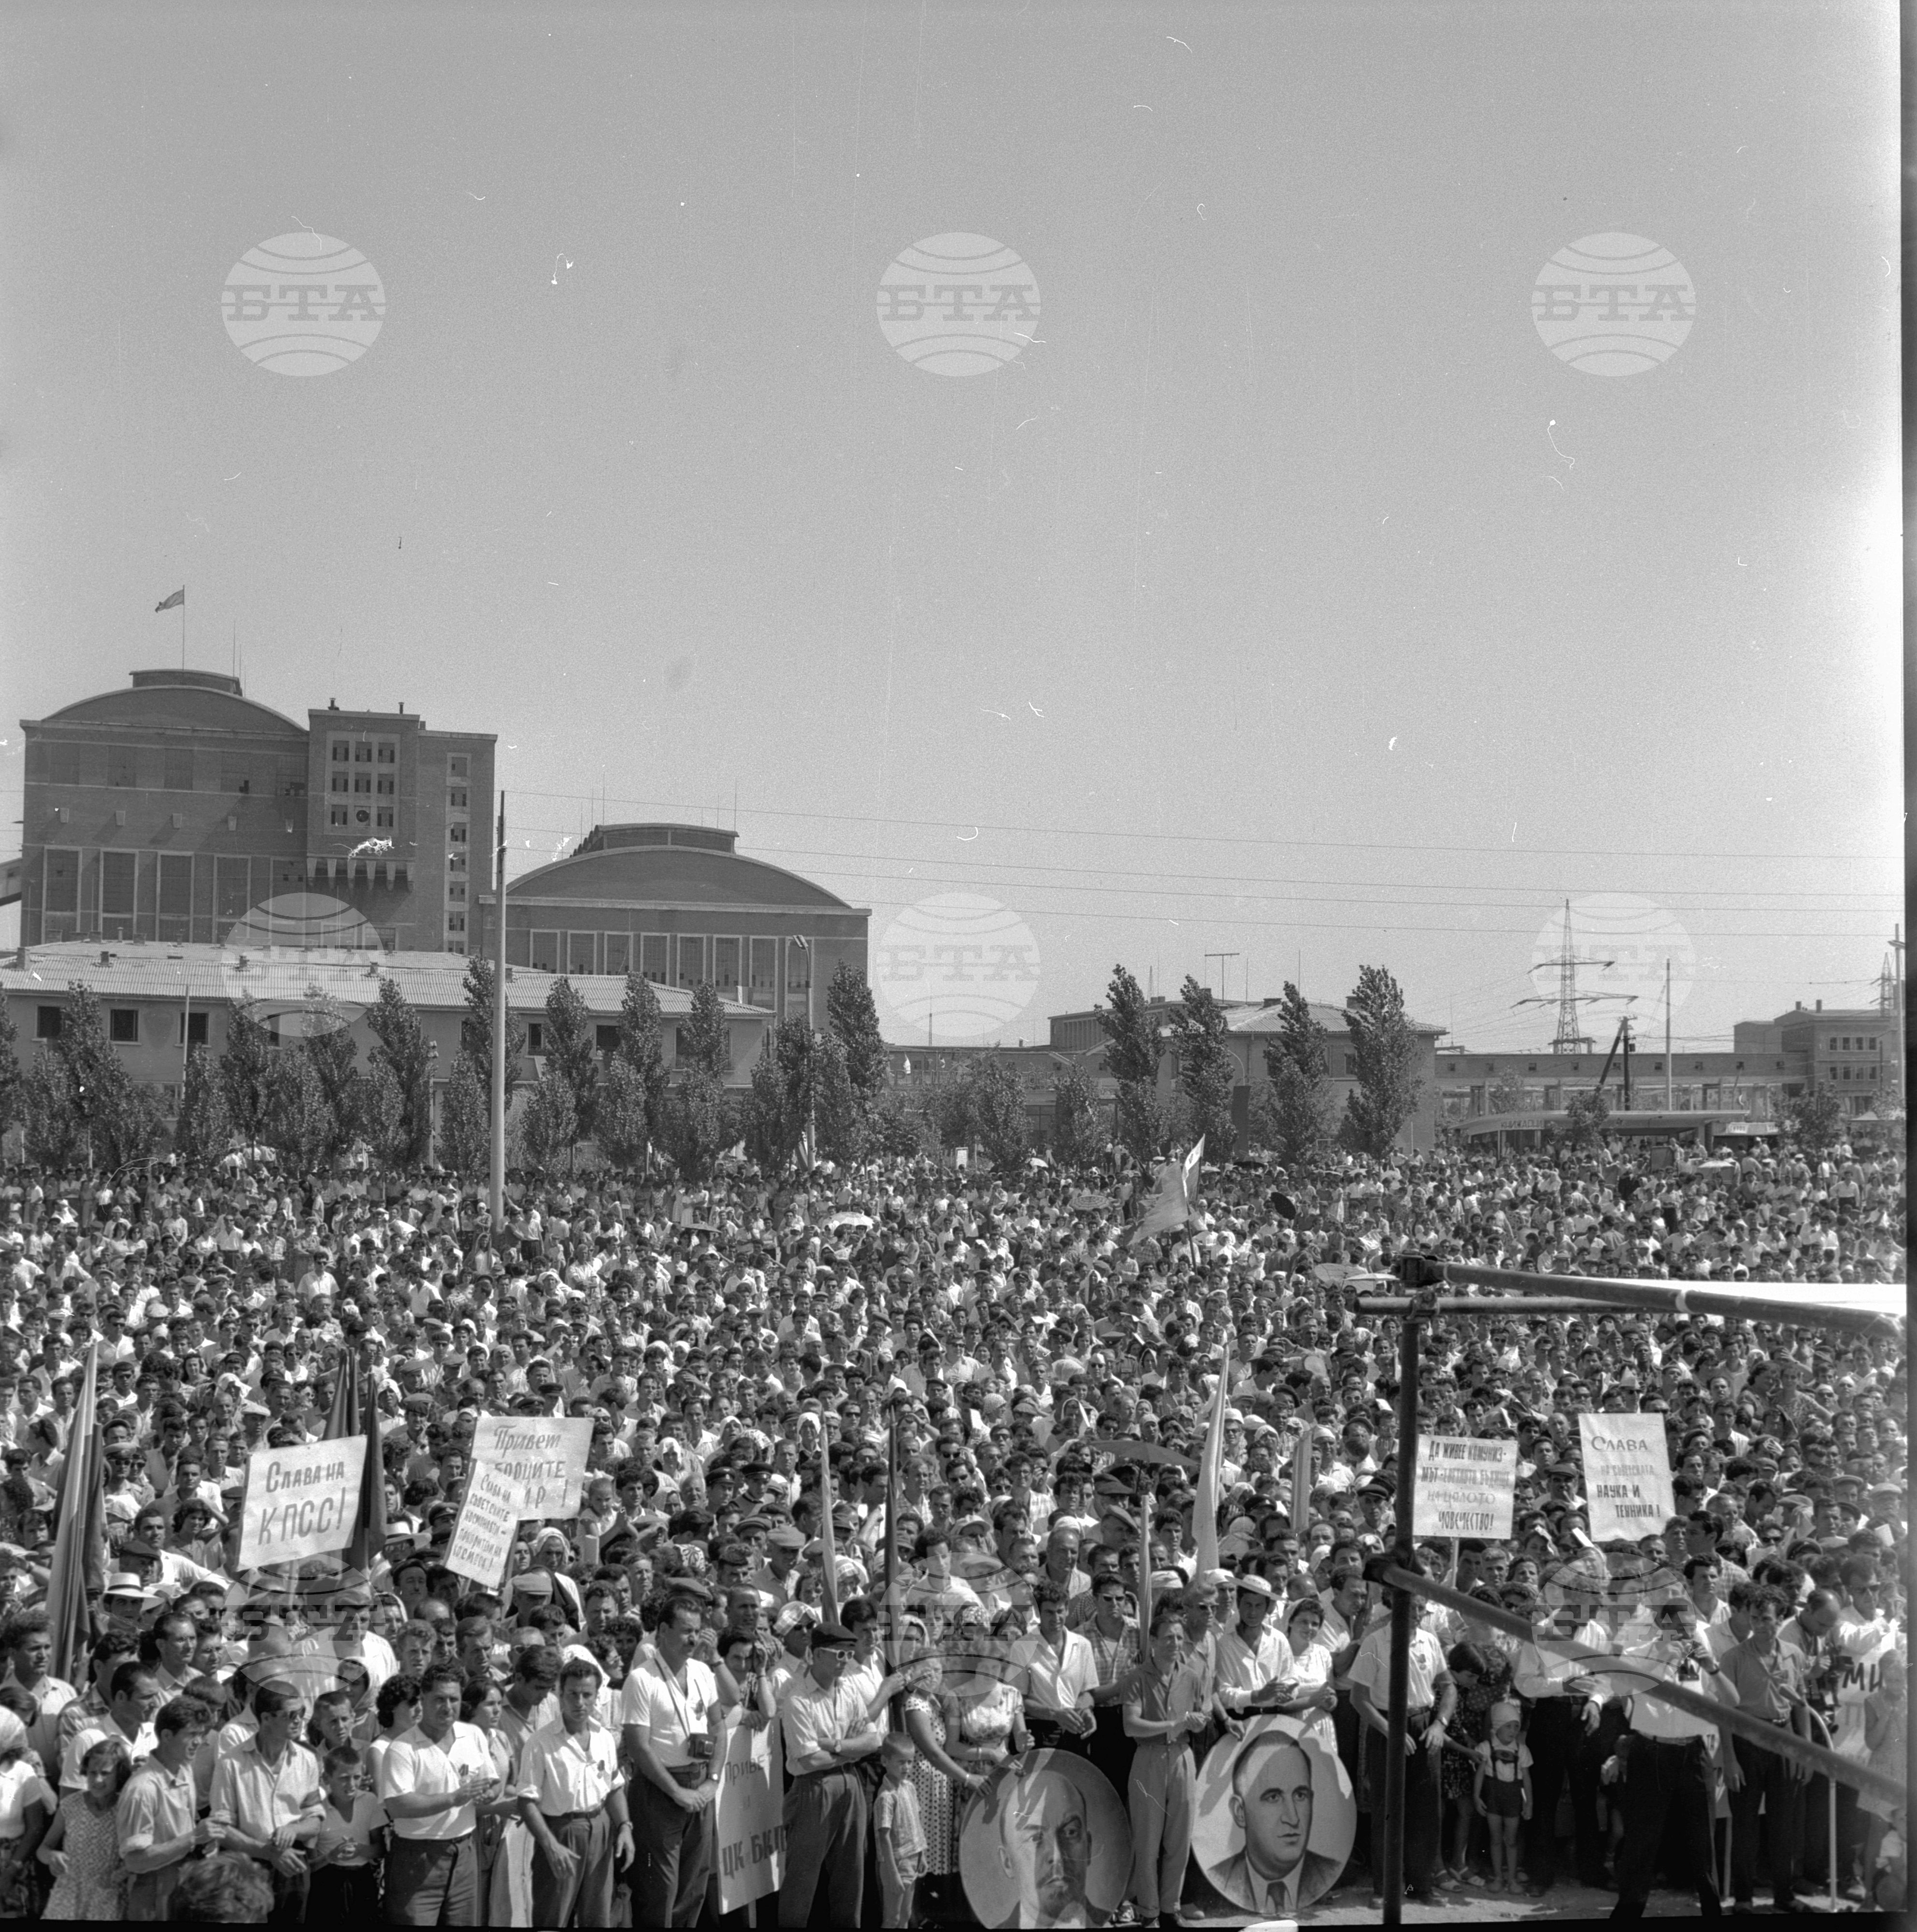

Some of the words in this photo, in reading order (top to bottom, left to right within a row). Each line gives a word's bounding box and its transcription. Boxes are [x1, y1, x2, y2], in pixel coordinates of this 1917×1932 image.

[494, 1425, 561, 1459] Привет
[1429, 1440, 1440, 1461] ДА
[1442, 1442, 1466, 1460] ЖИВЕЕ
[1591, 1436, 1648, 1451] СЛАВА
[266, 1461, 321, 1493] СЛАВА
[326, 1461, 344, 1482] НА
[1421, 1466, 1439, 1482] МЪТ
[1596, 1484, 1628, 1498] НАУКА
[1632, 1484, 1641, 1498] И
[258, 1486, 346, 1546] КПСС!
[1438, 1510, 1494, 1531] ЧОВЕЧЕСТВО!
[722, 1840, 745, 1880] ЦК
